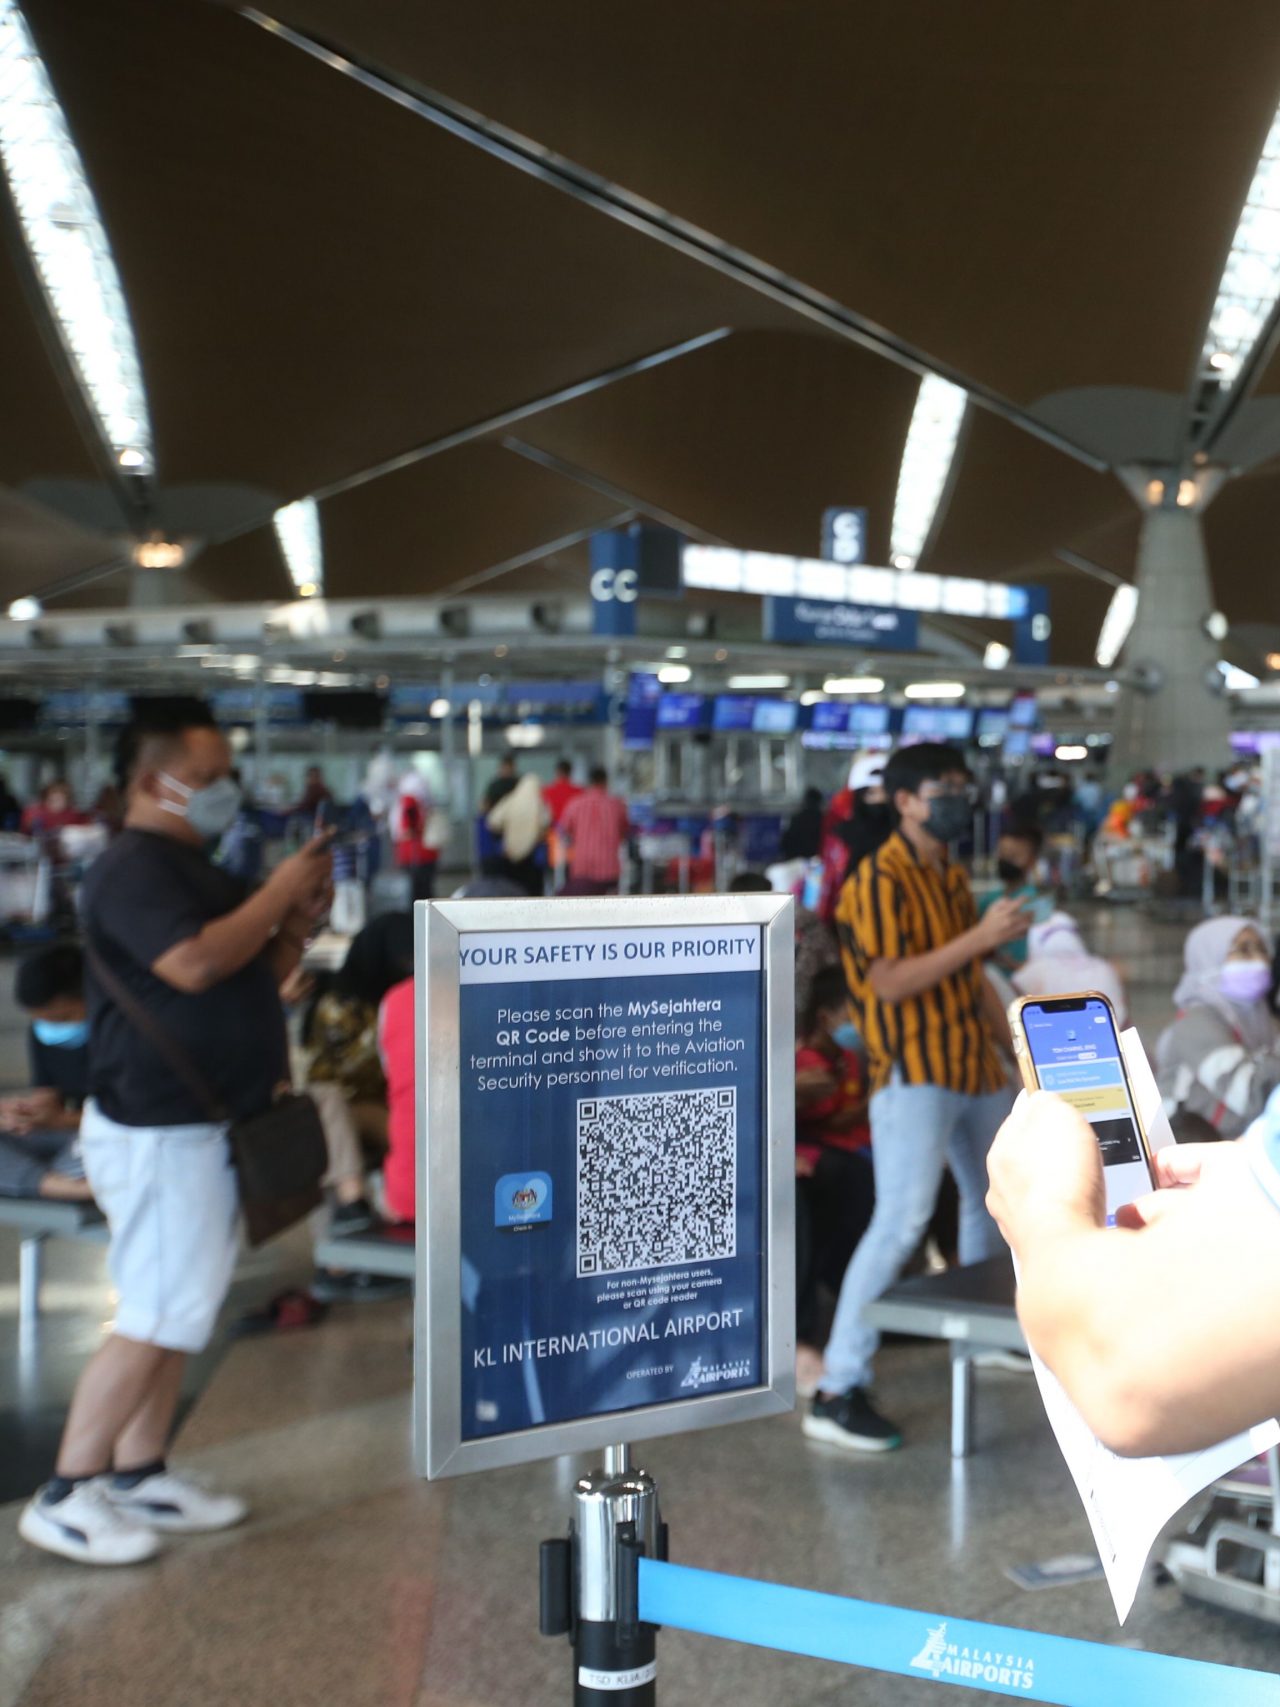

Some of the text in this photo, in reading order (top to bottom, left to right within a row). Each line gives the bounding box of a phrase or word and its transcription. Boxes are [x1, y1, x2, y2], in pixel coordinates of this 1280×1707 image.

[459, 938, 756, 966] YOUR SAFETY IS OUR PRIORITY
[497, 998, 721, 1024] Please scan the MySejahtera
[496, 1018, 722, 1046] QR Code before entering the
[470, 1037, 745, 1070] terminal and show it to the Aviation
[477, 1058, 738, 1091] Security personnel for verification.
[597, 1278, 722, 1304] please scan using your camera
[607, 1281, 619, 1290] For
[691, 1268, 714, 1278] users,
[623, 1292, 698, 1310] or QR code reader
[474, 1309, 744, 1368] KL INTERNATIONAL AIRPORT
[626, 1364, 674, 1380] OPERATED BY
[699, 1366, 750, 1384] AIRPORTS
[947, 1643, 1034, 1671] MALAYSIA
[943, 1656, 1034, 1689] AIRPORTS
